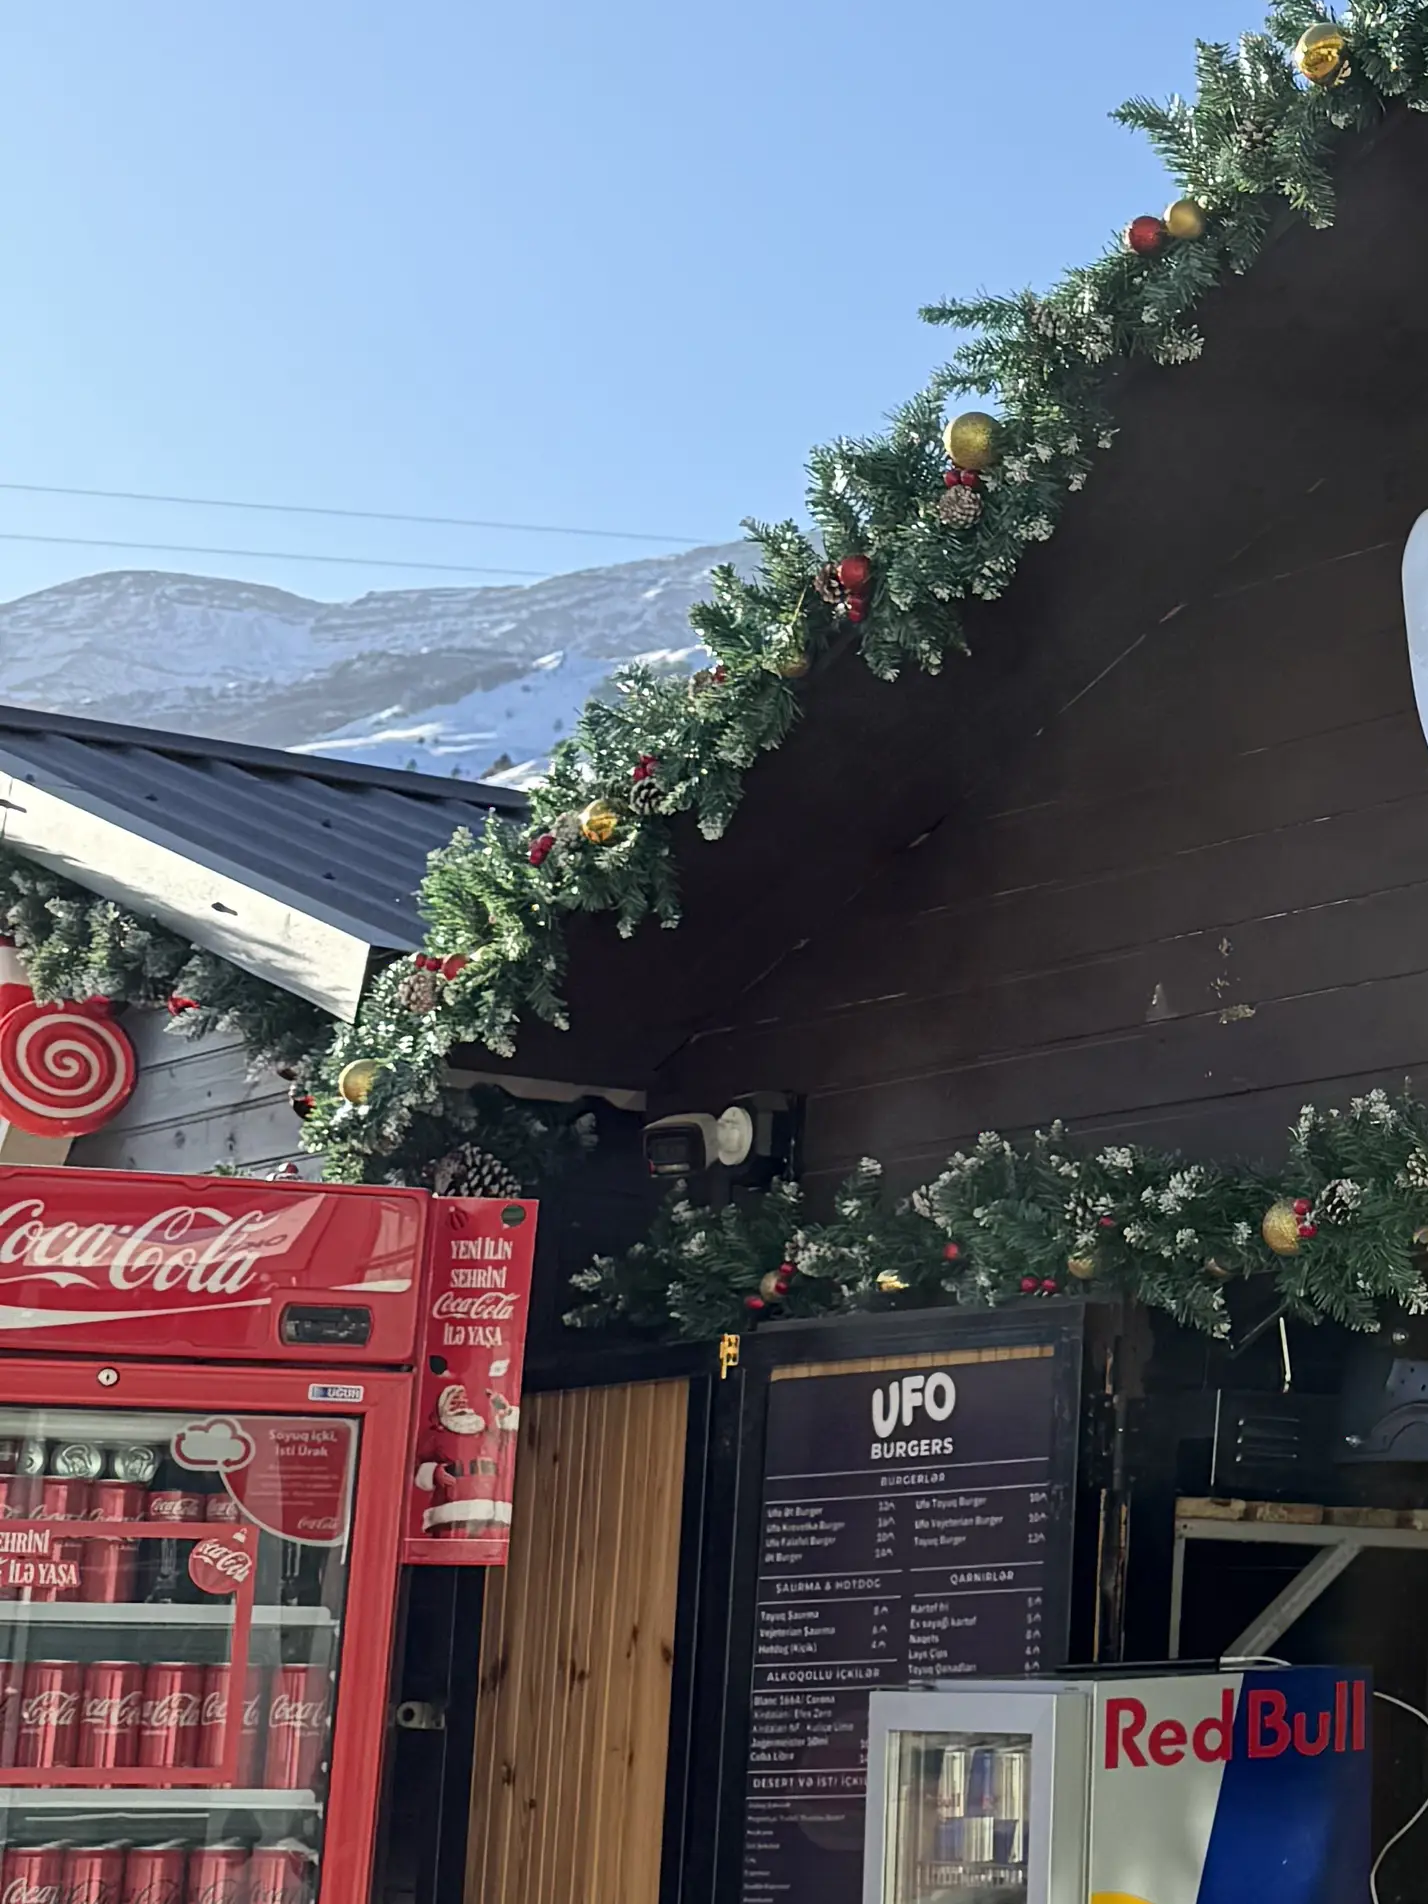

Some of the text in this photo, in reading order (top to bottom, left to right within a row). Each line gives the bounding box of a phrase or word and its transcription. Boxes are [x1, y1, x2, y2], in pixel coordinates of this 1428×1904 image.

[872, 1372, 956, 1438] UFO
[870, 1437, 954, 1460] BURGERS
[1105, 1680, 1366, 1769] Red Bull
